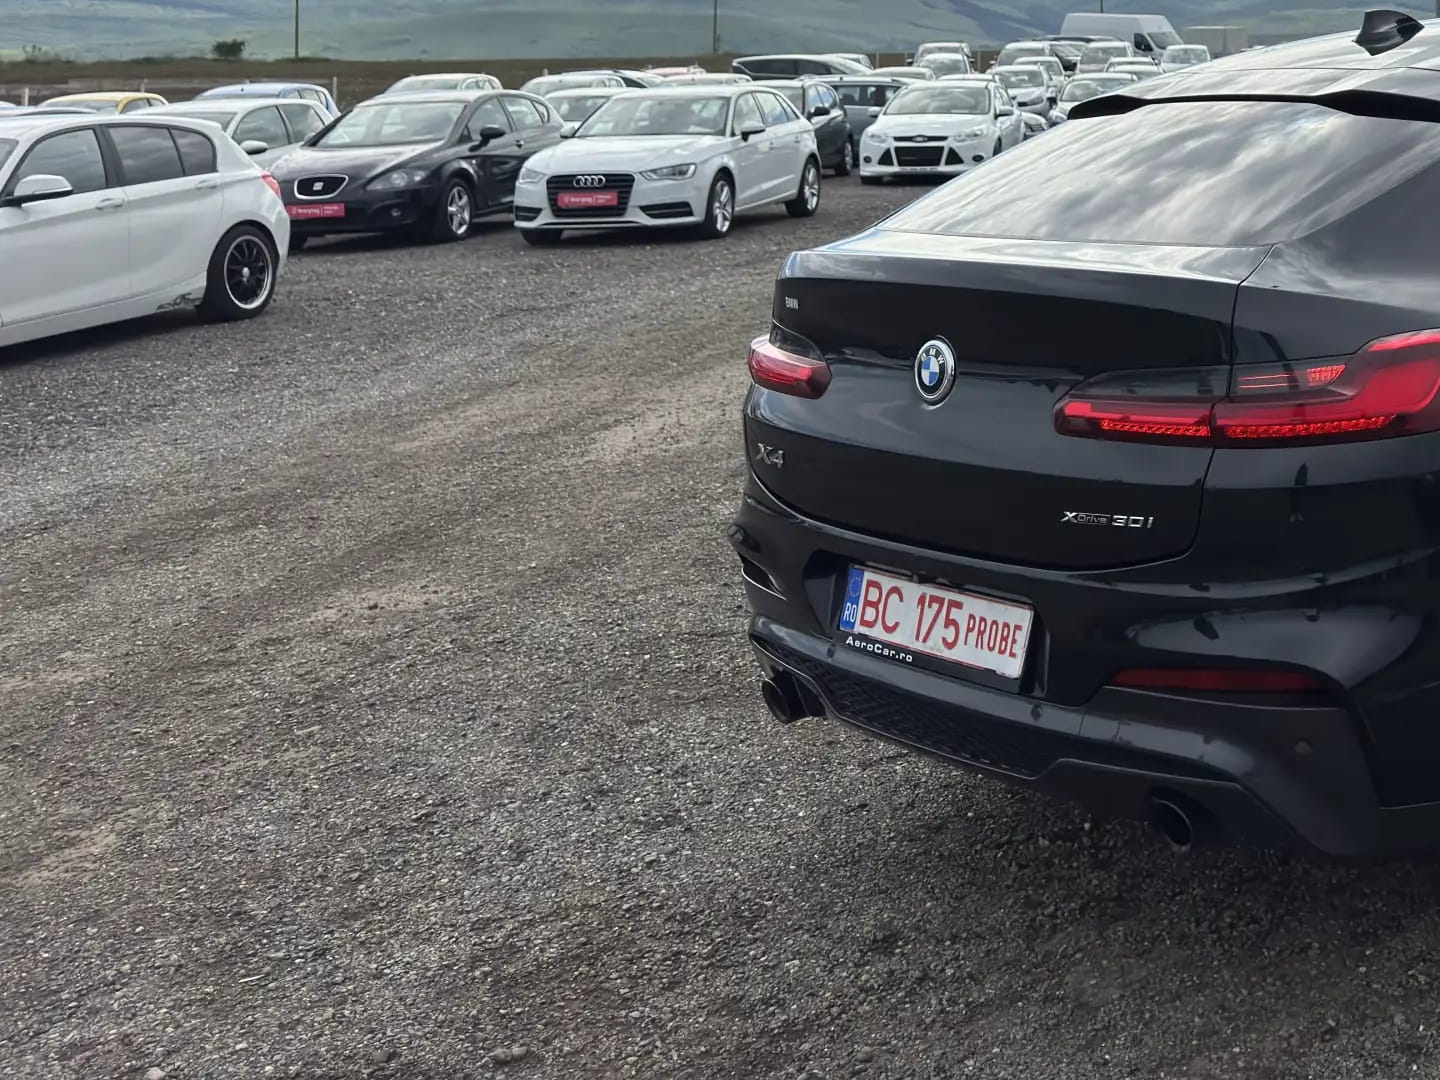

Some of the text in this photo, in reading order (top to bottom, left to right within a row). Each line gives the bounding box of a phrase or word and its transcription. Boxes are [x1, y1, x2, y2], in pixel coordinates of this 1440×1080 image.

[785, 296, 799, 310] BMW
[920, 348, 945, 365] BMW
[756, 442, 785, 469] X4
[843, 602, 857, 624] RO
[859, 579, 1023, 659] BC 175 PROBE
[845, 636, 913, 663] AeroCar.ro
